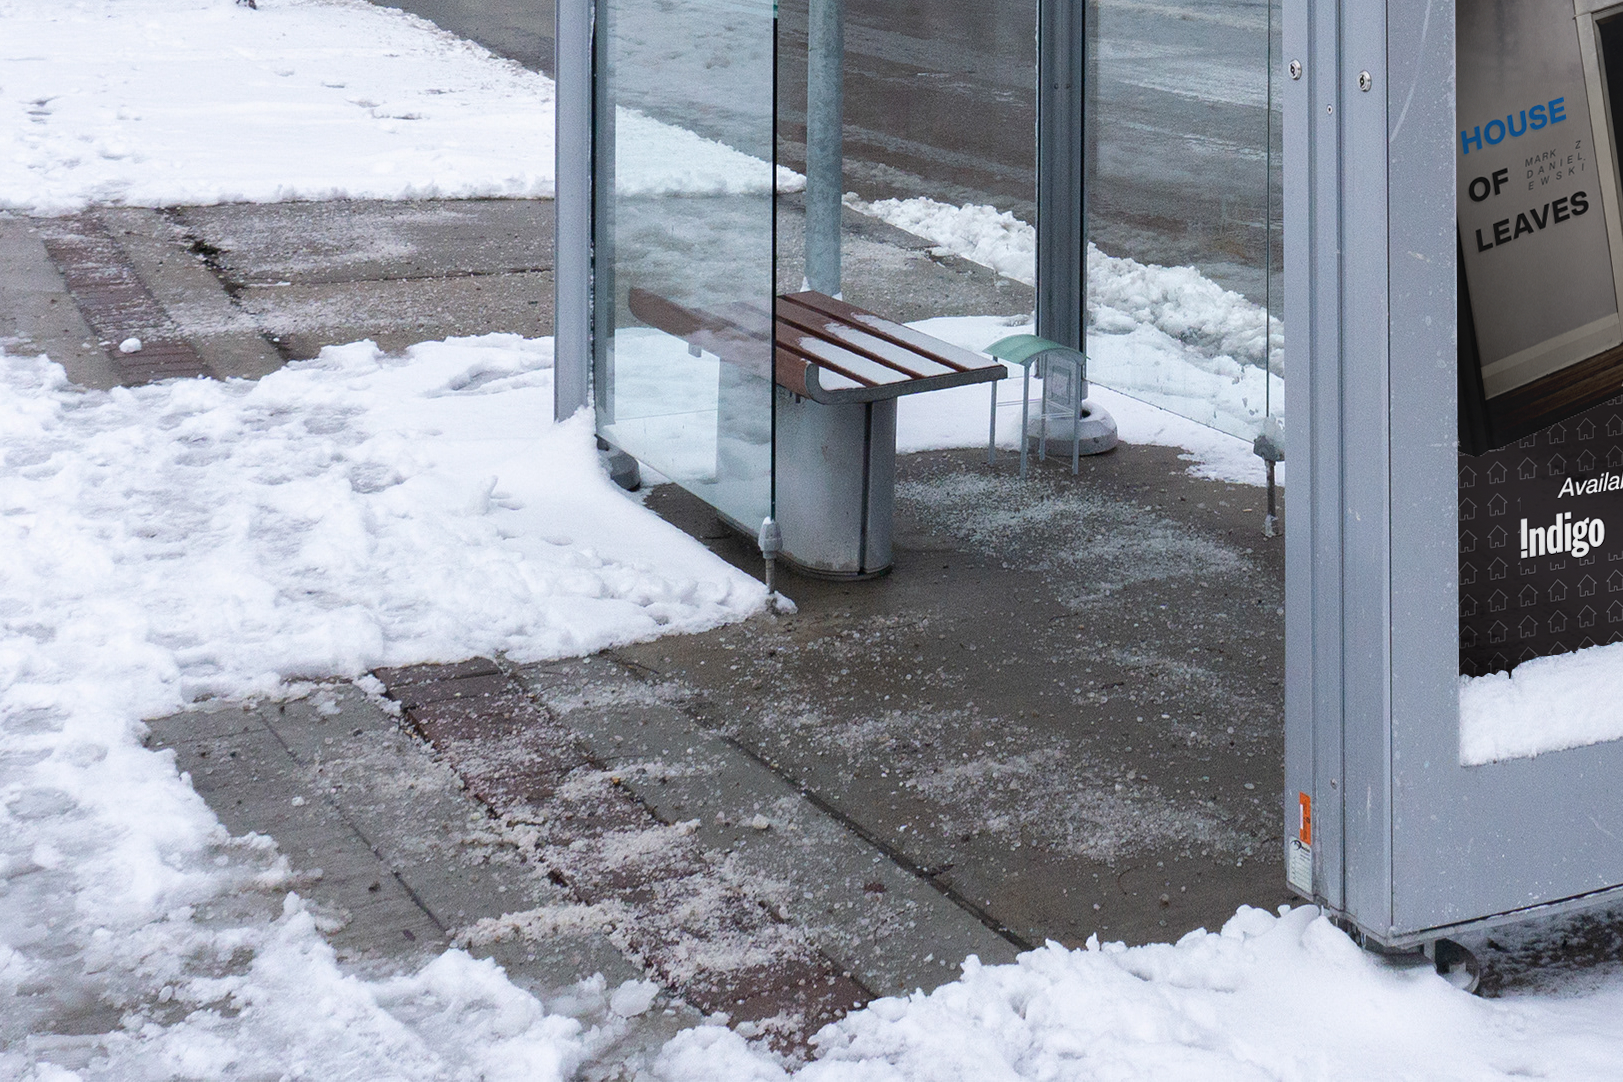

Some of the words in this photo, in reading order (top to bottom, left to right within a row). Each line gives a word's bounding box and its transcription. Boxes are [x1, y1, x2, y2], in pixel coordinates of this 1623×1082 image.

[1460, 96, 1567, 155] HOUSE
[1524, 148, 1557, 168] MARK
[1468, 167, 1509, 203] OF
[1475, 191, 1590, 253] LEAVES
